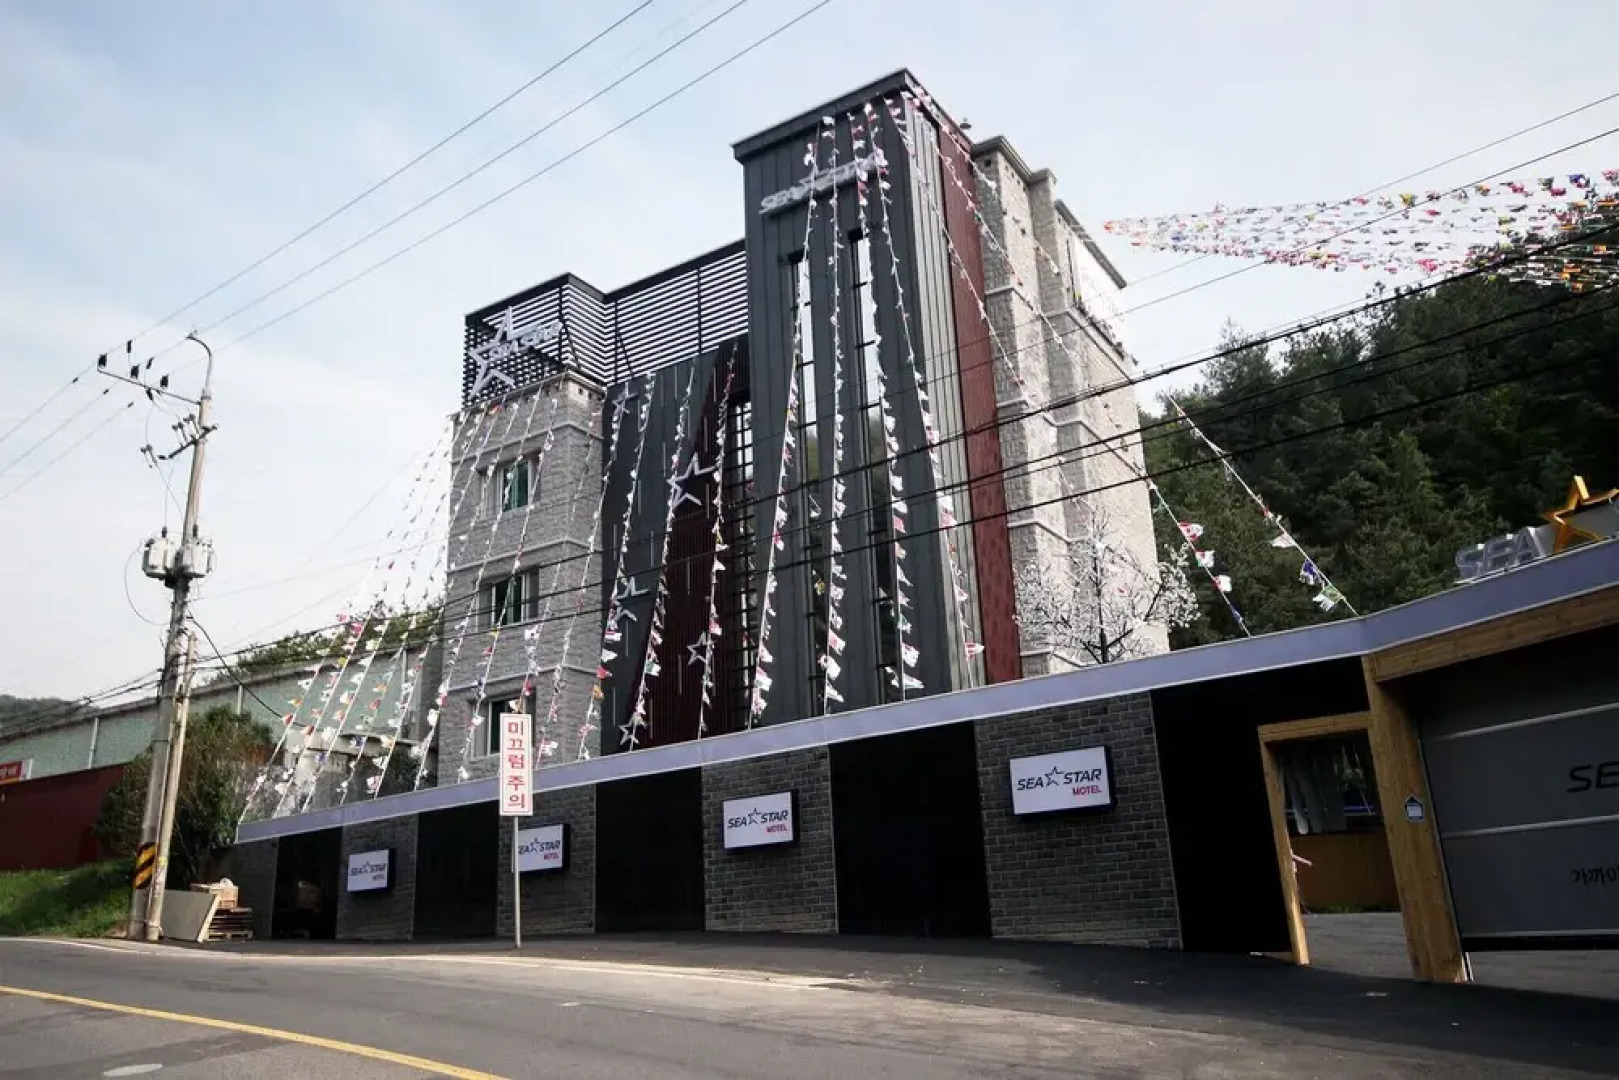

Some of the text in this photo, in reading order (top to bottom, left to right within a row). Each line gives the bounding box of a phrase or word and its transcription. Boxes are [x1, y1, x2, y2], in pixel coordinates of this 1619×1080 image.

[1454, 526, 1546, 582] SEA
[507, 721, 525, 808] 미끄럼 주의
[1016, 768, 1102, 790] SEA STAR
[1072, 785, 1102, 796] MOTEL
[727, 809, 789, 829] SEA STAR
[539, 839, 561, 852] STAR
